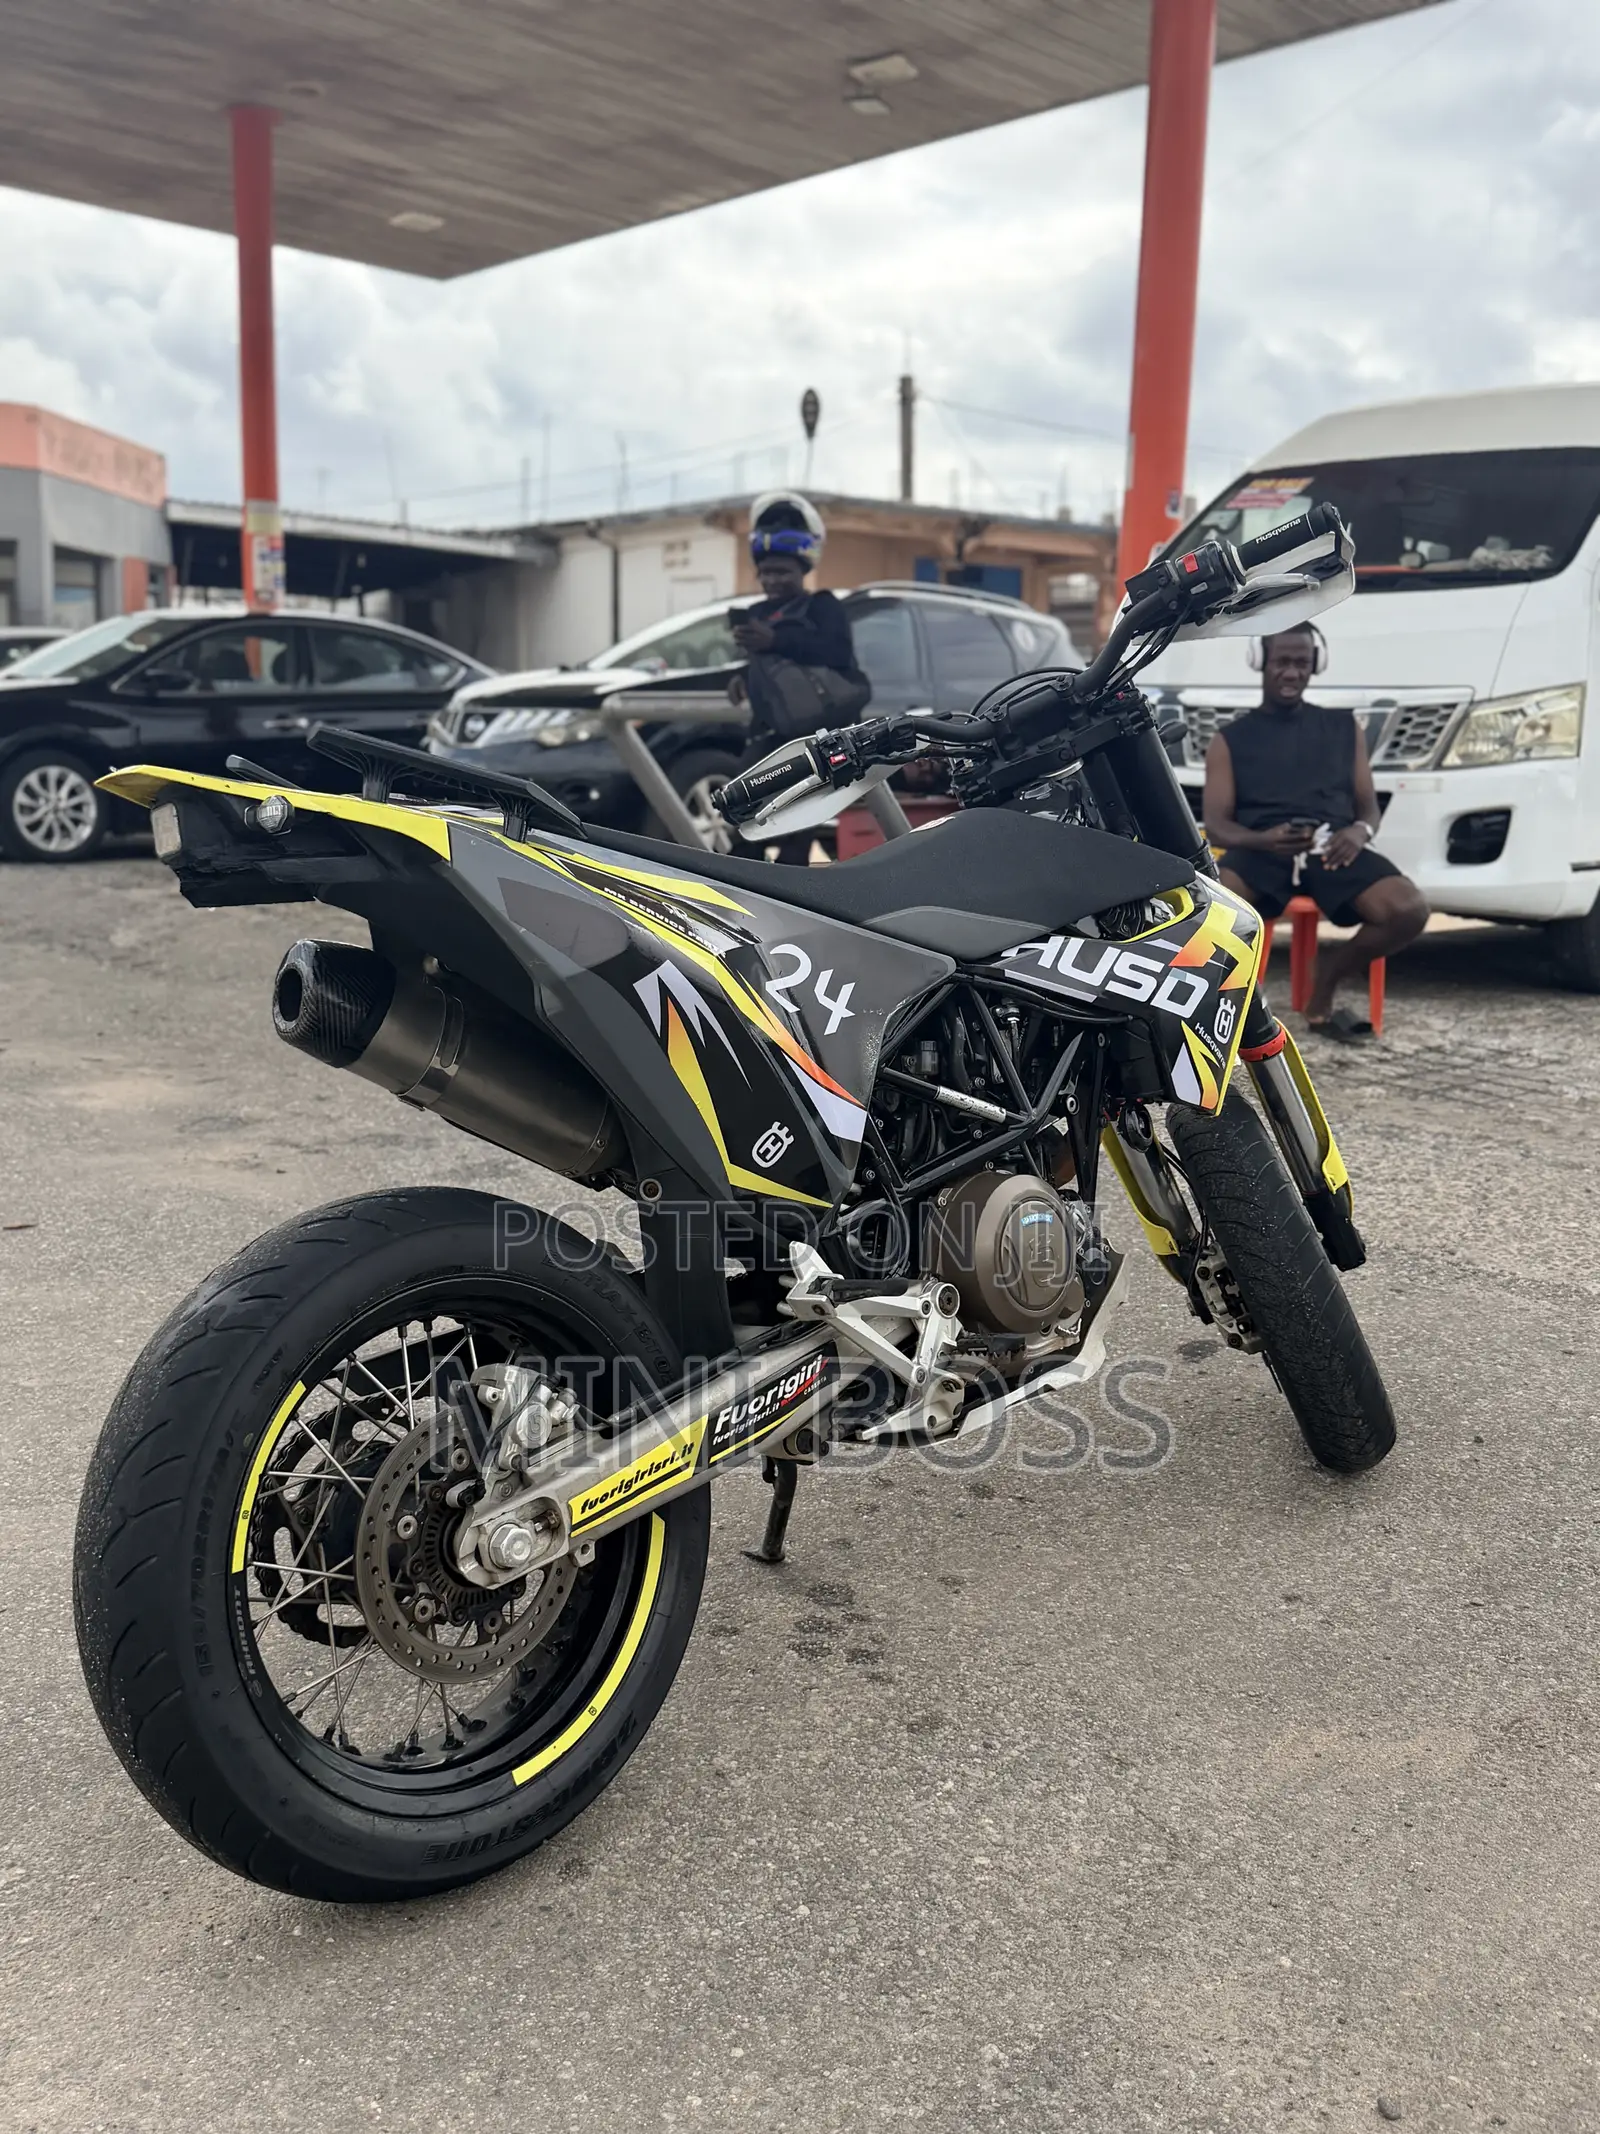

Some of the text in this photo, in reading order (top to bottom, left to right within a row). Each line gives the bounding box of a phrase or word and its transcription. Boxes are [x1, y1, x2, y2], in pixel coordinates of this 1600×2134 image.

[1255, 518, 1301, 544] Husqvarna
[749, 763, 793, 788] Husqvarna
[629, 899, 686, 932] SERVICE
[765, 943, 856, 1036] 24
[1194, 1022, 1227, 1069] Husqvarna
[714, 1354, 823, 1434] Fuorigiri
[712, 1402, 780, 1446] fuorigirisrl.it
[579, 1442, 695, 1515] fuorigirisrl.it
